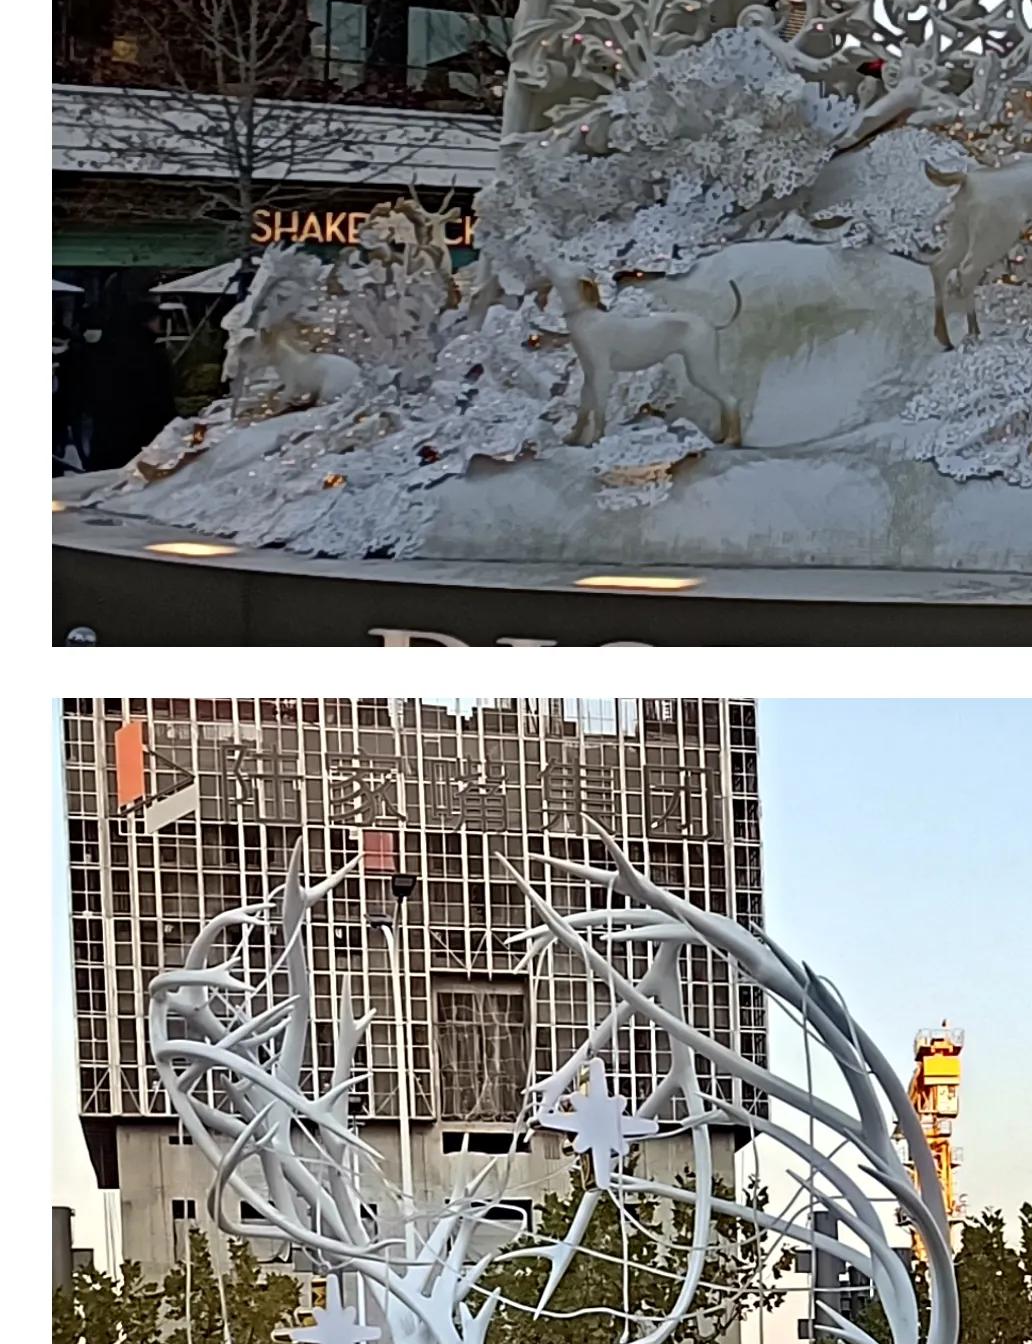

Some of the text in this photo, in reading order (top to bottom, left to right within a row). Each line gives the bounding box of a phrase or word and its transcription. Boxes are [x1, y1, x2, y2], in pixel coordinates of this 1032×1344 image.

[251, 209, 368, 244] SHAKE
[220, 744, 714, 841] 陆家嘴集团
